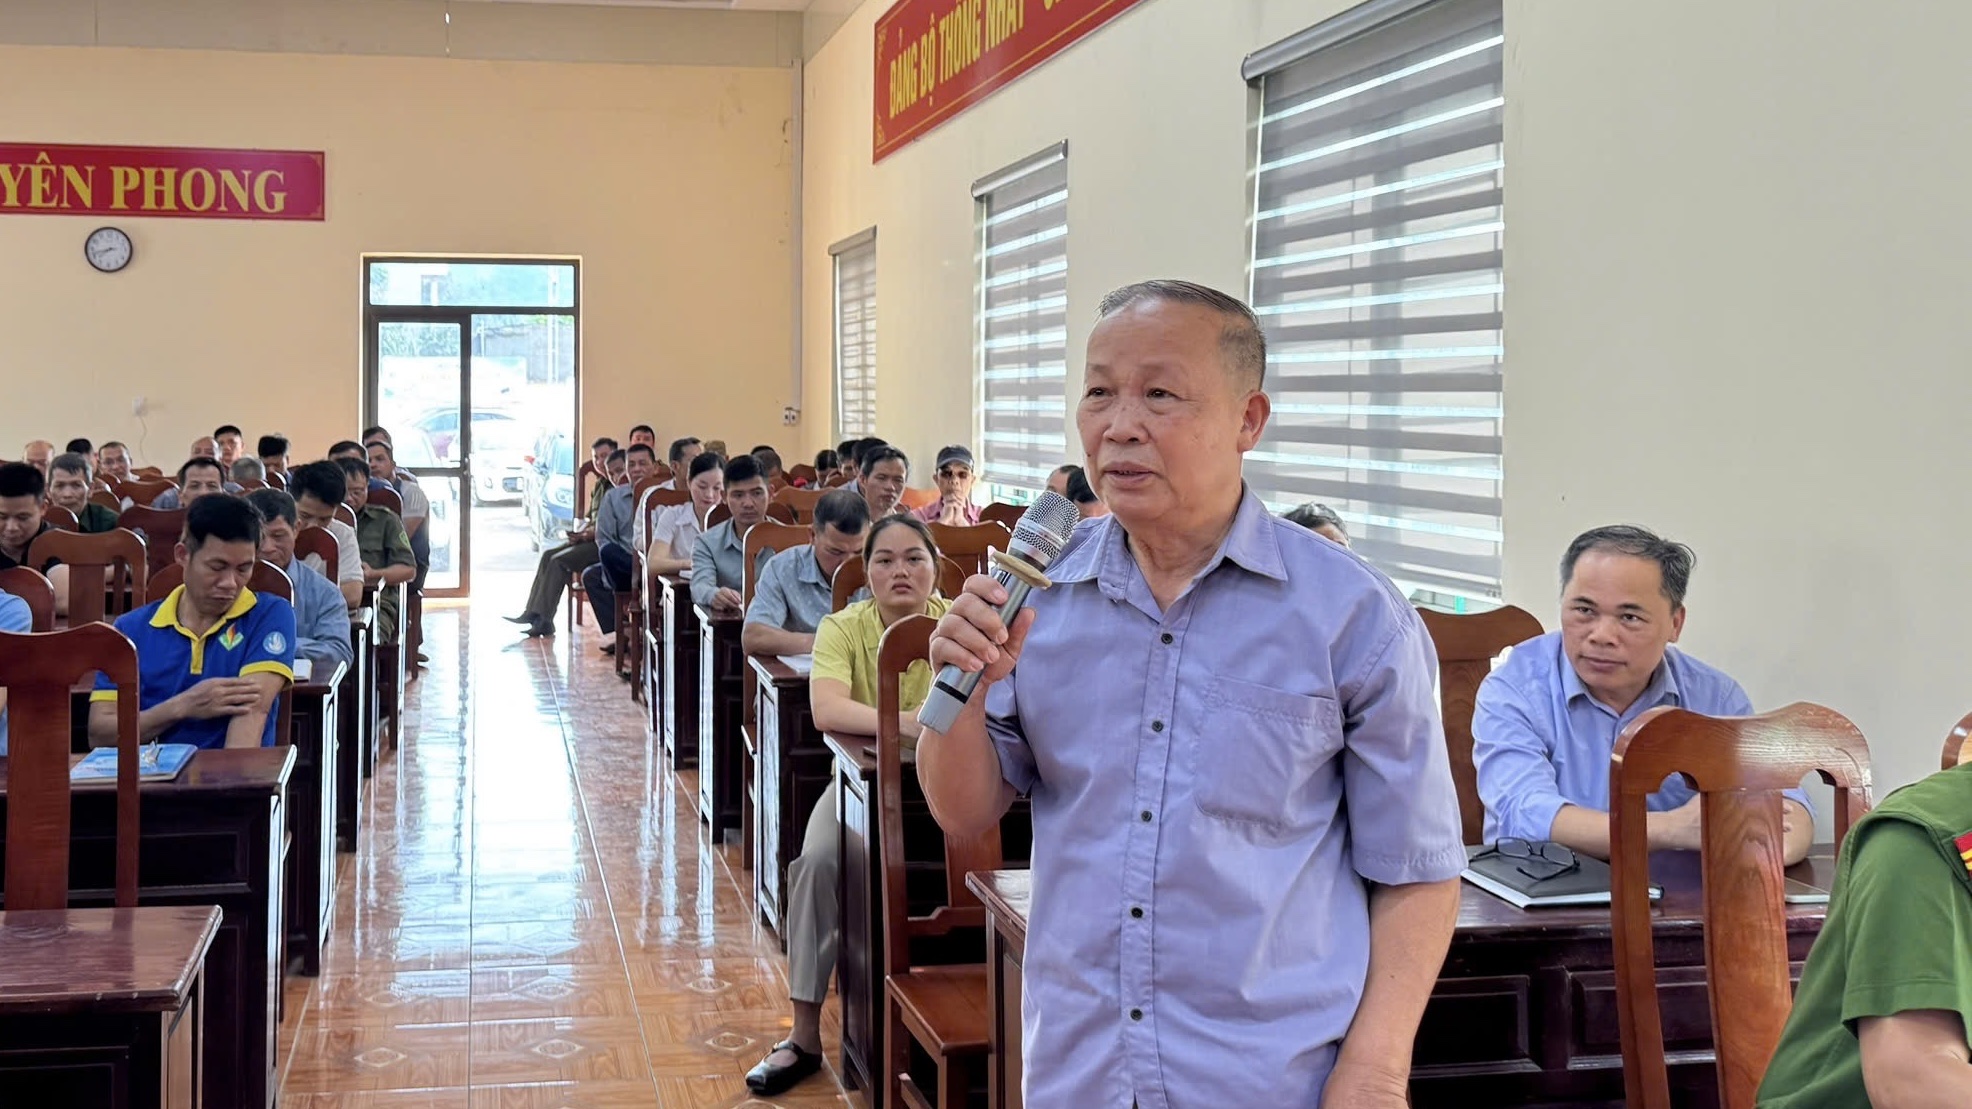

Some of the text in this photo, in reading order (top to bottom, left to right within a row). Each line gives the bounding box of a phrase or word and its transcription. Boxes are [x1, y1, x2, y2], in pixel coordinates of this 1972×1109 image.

[889, 27, 918, 119] ĐẢNG
[920, 12, 936, 107] BỘ
[0, 151, 288, 213] YÊN PHONG
